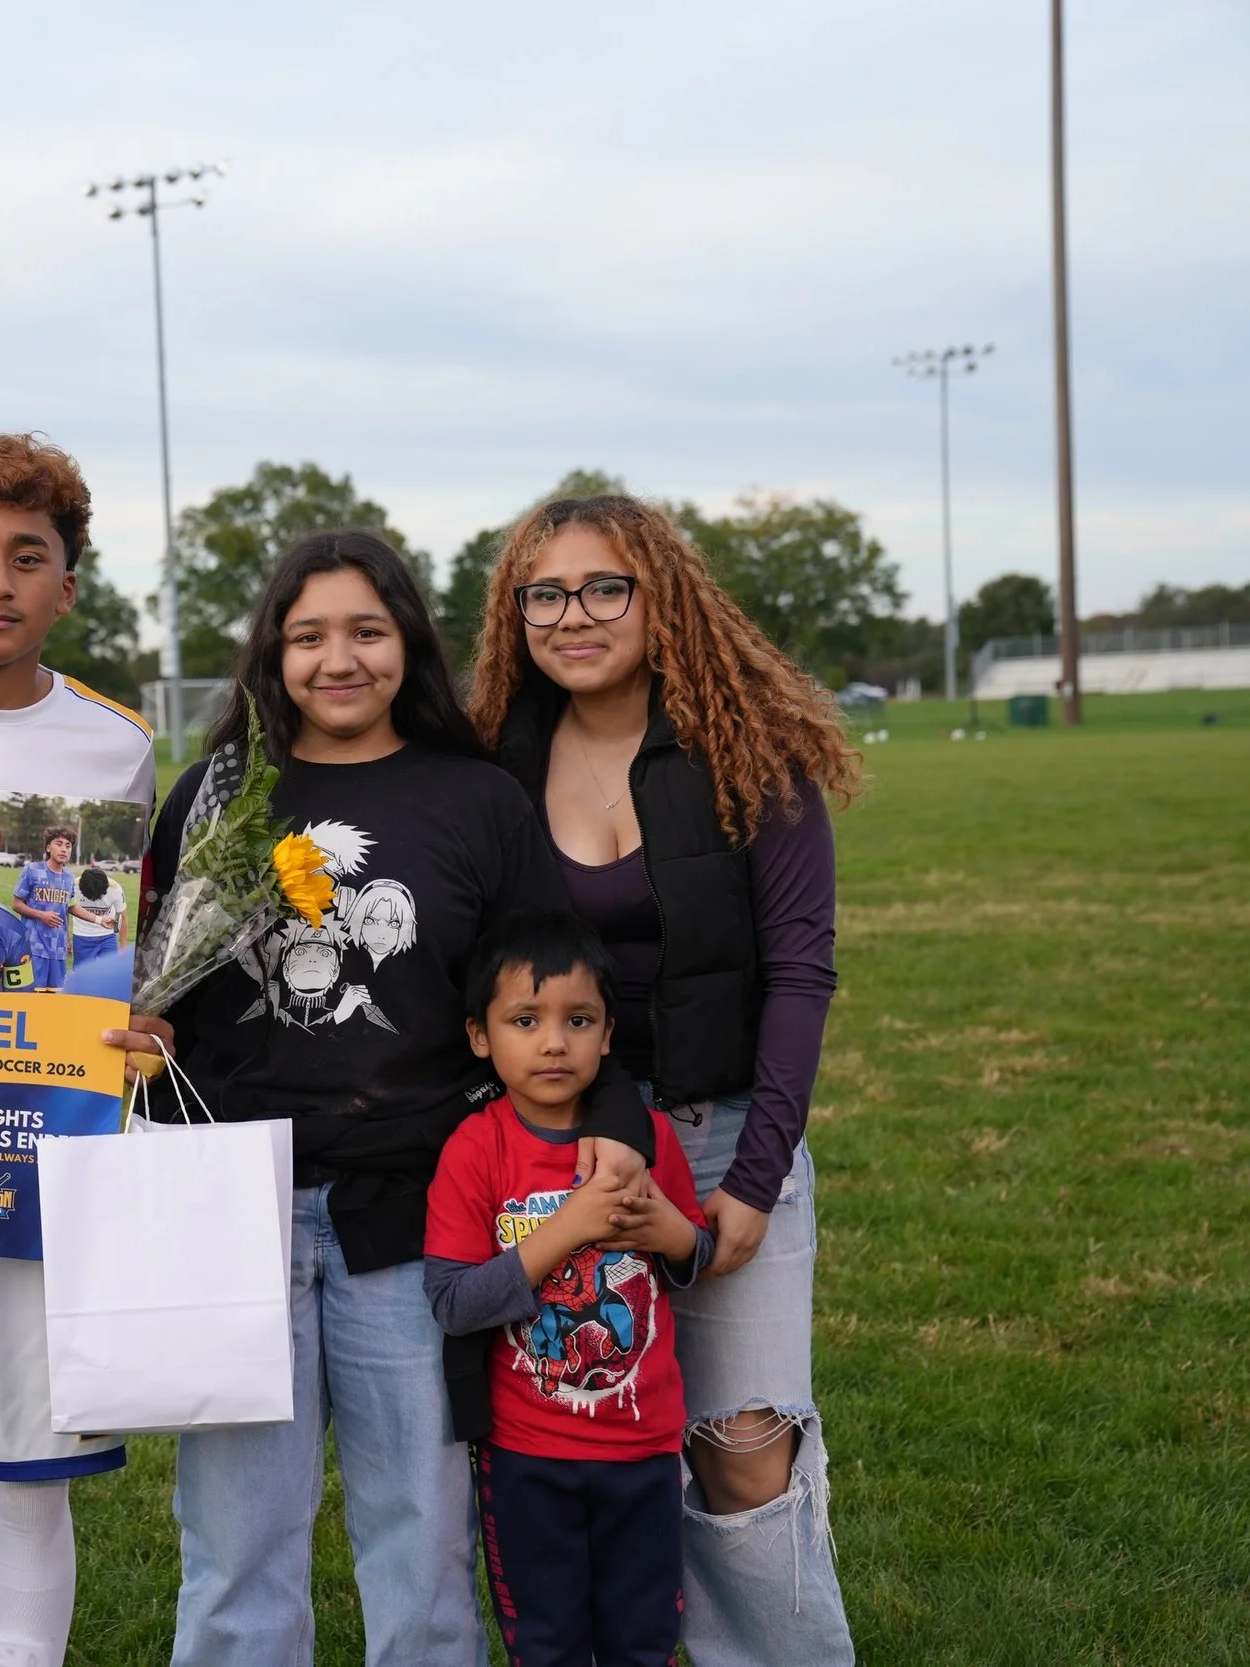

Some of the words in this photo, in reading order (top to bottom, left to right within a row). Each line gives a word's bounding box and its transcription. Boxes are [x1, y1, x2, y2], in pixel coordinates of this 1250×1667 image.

[6, 969, 21, 986] C
[45, 1062, 86, 1078] 2026
[505, 1199, 527, 1213] the
[527, 1192, 574, 1215] AMA
[498, 1214, 550, 1245] SPI
